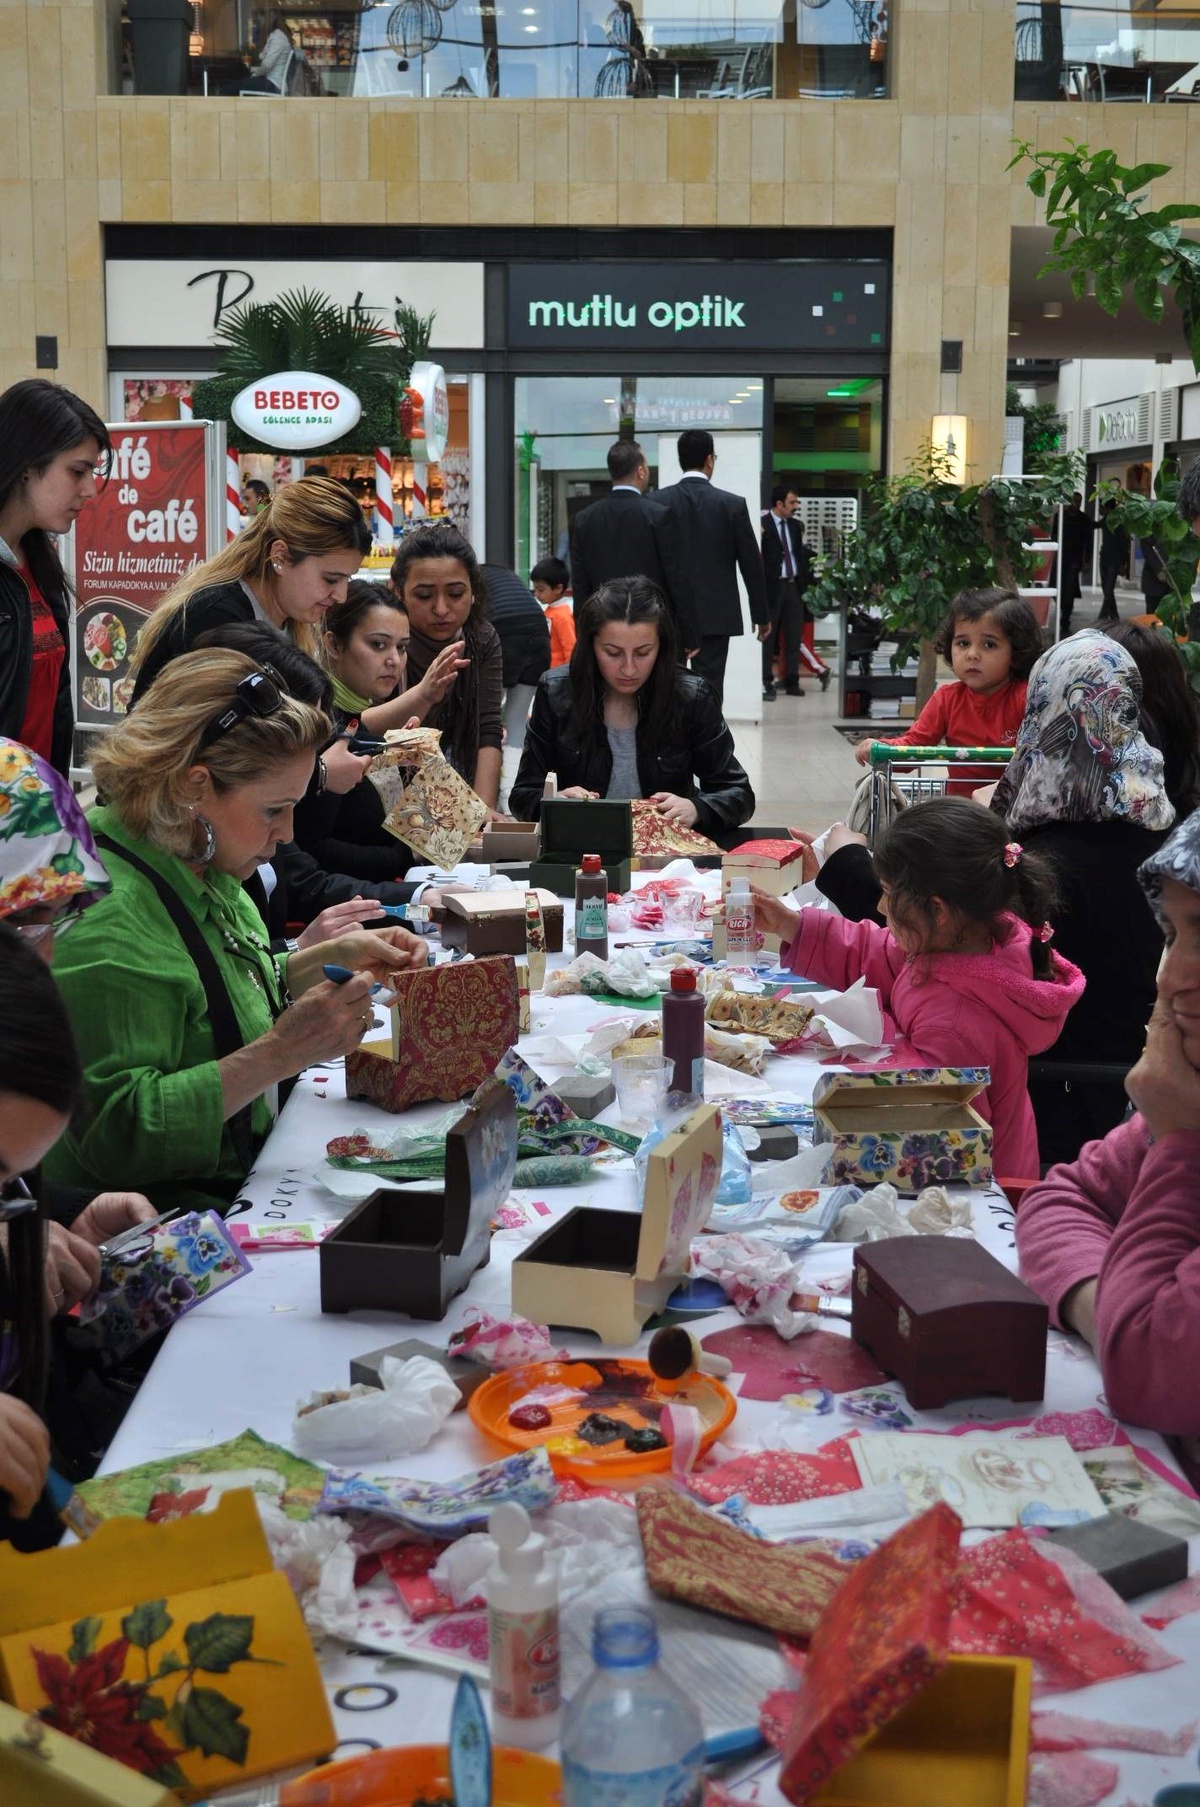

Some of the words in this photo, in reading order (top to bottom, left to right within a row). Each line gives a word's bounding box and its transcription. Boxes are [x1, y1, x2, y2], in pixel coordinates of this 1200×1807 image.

[528, 294, 637, 328] mutlu
[647, 294, 746, 332] optik
[254, 390, 340, 411] BEBETO
[305, 415, 333, 425] ADASI
[92, 436, 151, 481] afé
[118, 484, 139, 506] de
[127, 499, 198, 544] café
[83, 550, 114, 574] Sizin
[117, 551, 185, 575] hizmetiniz
[83, 579, 108, 589] FORUM
[728, 919, 749, 930] RICH
